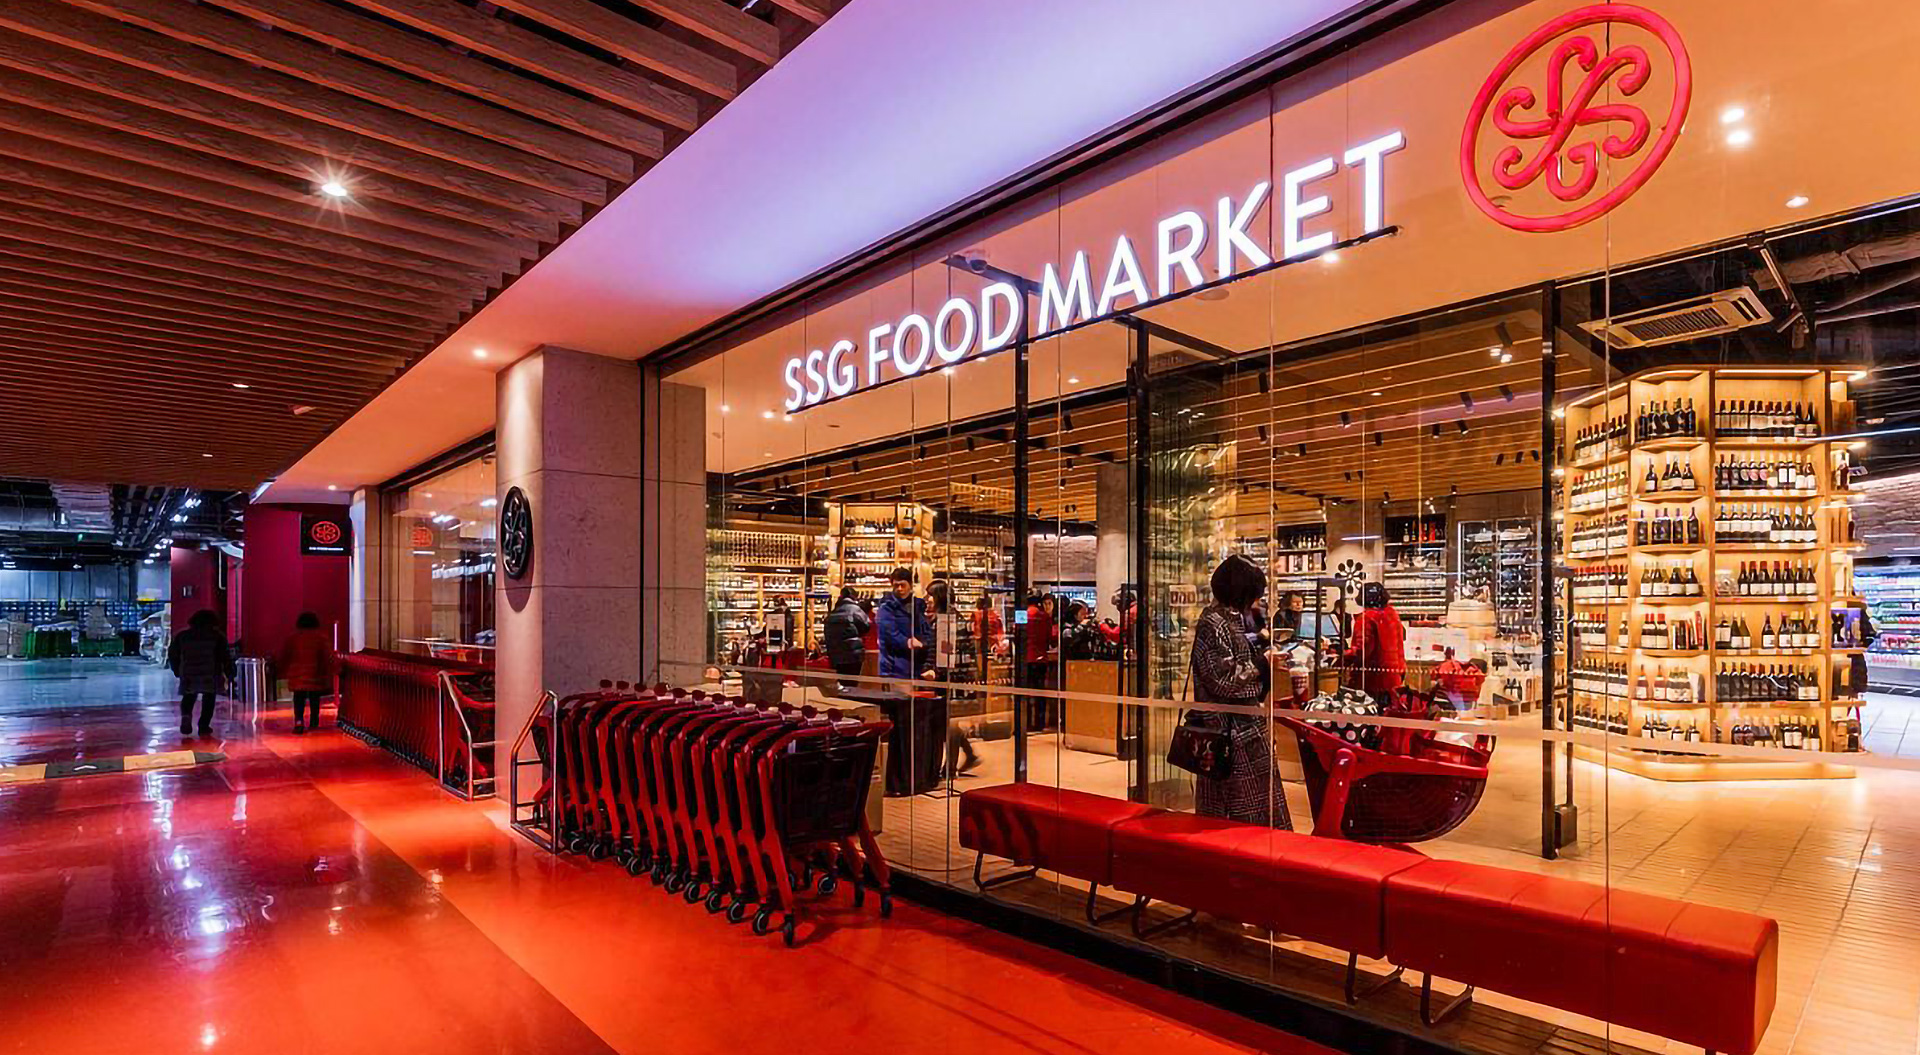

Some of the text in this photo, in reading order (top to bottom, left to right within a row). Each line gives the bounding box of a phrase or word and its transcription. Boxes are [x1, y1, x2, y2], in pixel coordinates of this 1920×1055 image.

[784, 130, 1404, 411] SSG FOOD MARKET
